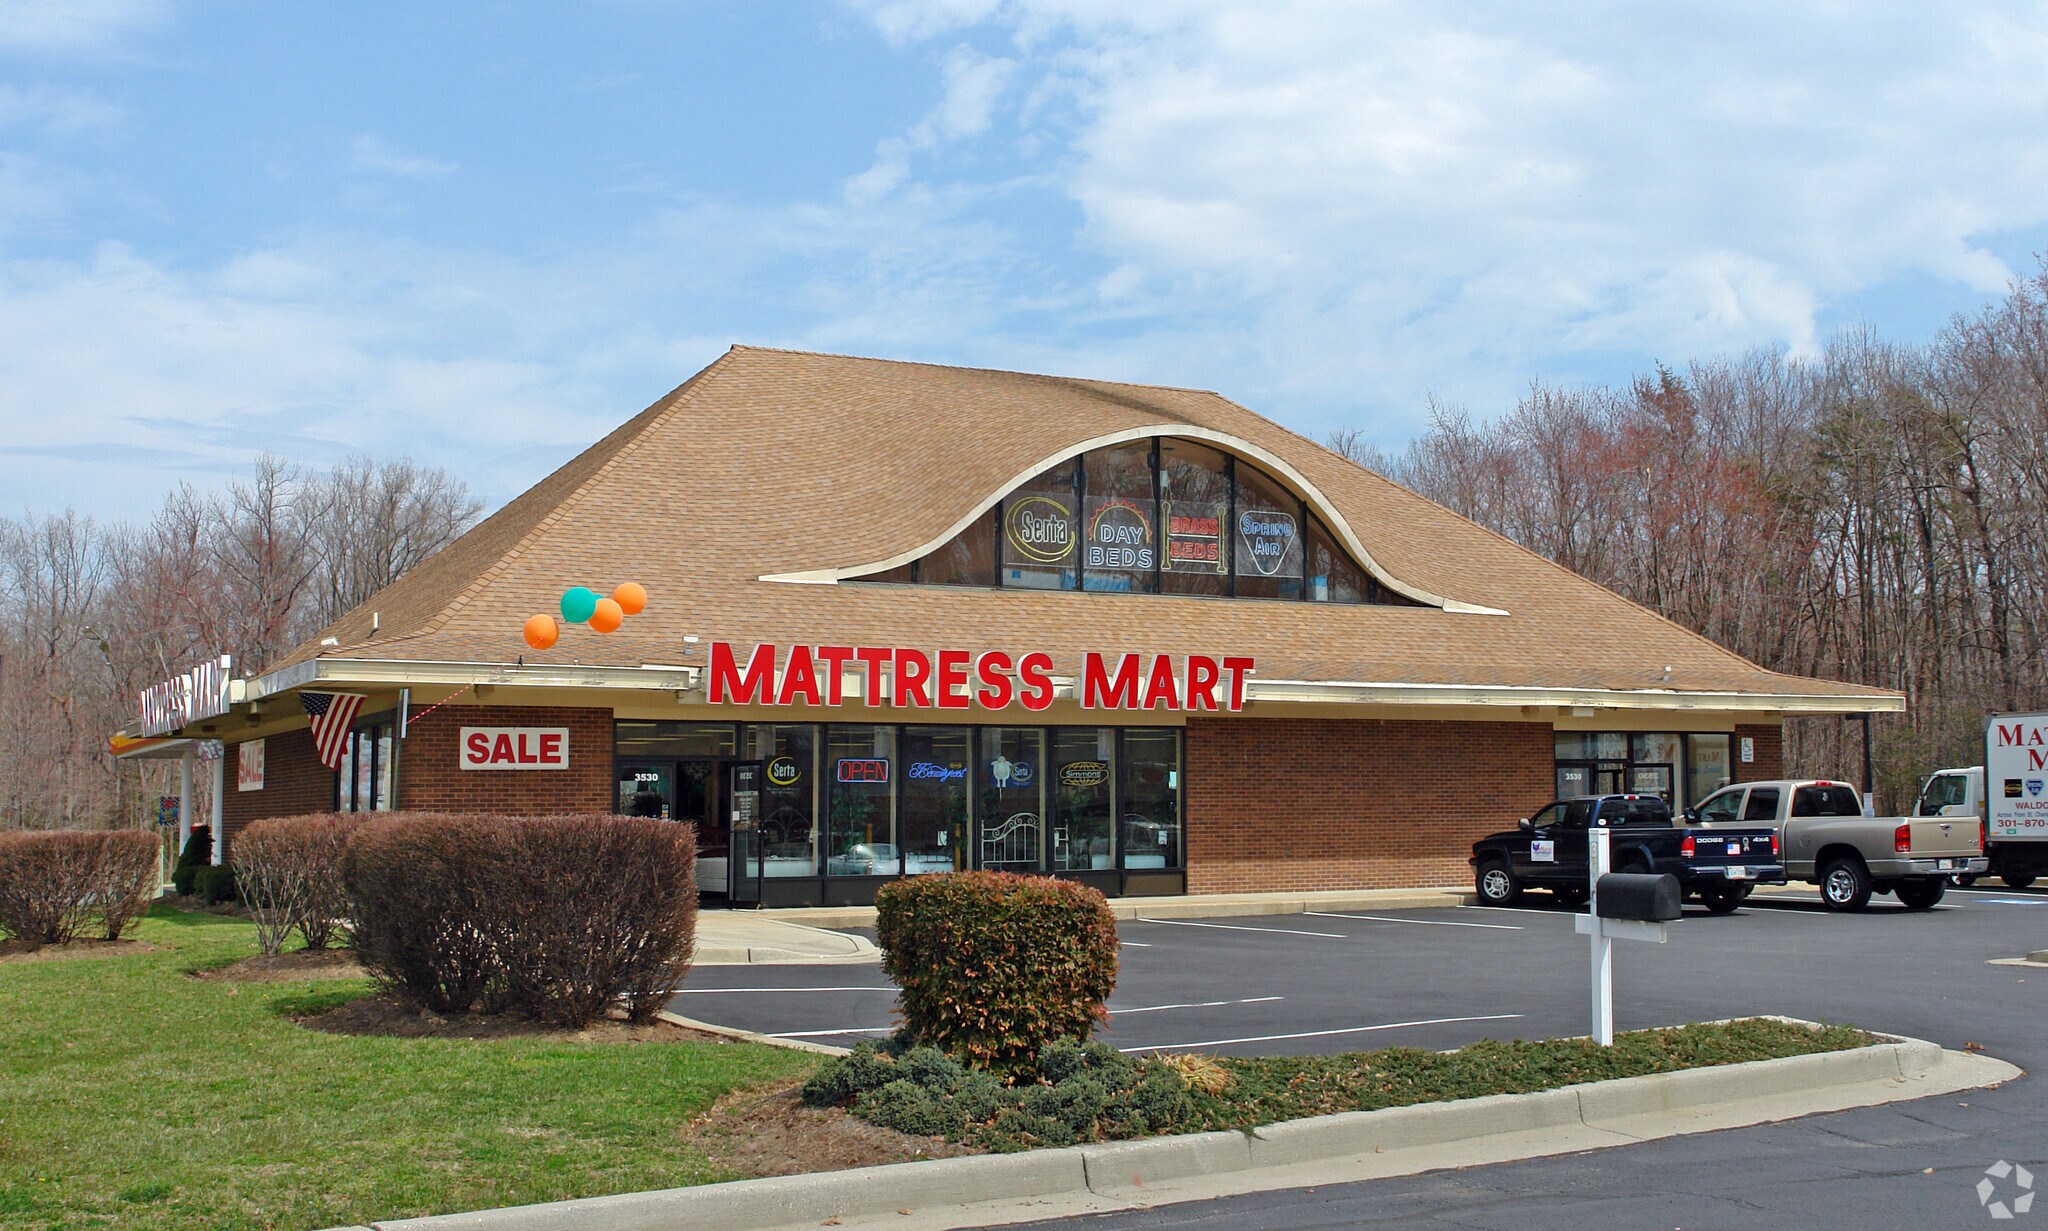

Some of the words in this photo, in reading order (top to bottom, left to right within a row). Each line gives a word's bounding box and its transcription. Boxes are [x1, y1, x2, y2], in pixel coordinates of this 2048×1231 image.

[1021, 510, 1069, 544] Serta
[1099, 524, 1144, 544] DAY
[1170, 516, 1219, 535] BRASS
[1242, 515, 1294, 537] SPRING
[1170, 541, 1219, 560] BEDS
[1254, 538, 1280, 556] AIR
[1089, 546, 1153, 569] BEDS
[706, 641, 1055, 711] MATTRESS
[1079, 651, 1256, 712] MART
[1997, 724, 2048, 747] MA
[467, 732, 562, 764] SALE
[239, 749, 262, 784] SALE
[774, 763, 795, 778] Serta
[839, 760, 887, 781] OPEN
[1014, 767, 1028, 777] Serta
[1065, 770, 1101, 778] Simmons
[634, 773, 658, 783] 3530
[1565, 773, 1582, 781] 3530
